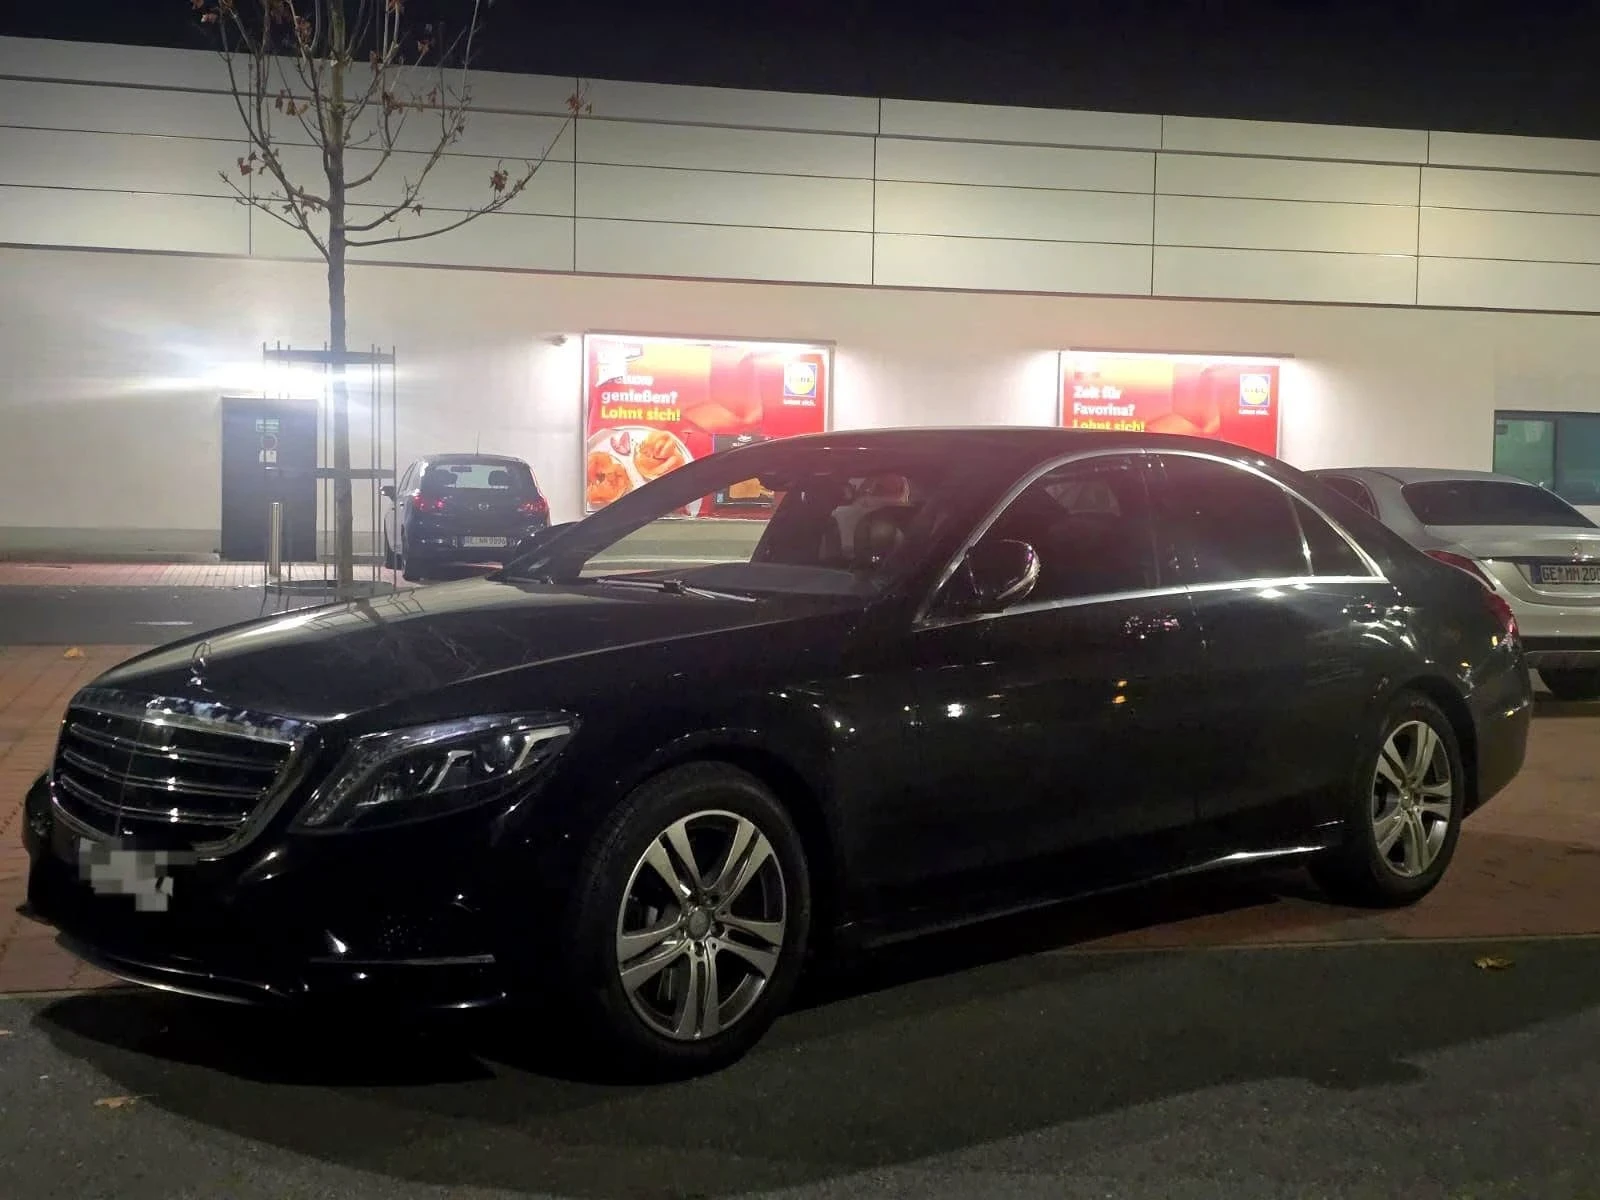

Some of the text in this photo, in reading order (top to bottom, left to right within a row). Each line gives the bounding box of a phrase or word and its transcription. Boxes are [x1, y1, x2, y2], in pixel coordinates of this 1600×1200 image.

[602, 389, 678, 404] genießen?
[602, 405, 681, 422] Lohnt sich!
[1074, 402, 1136, 417] Favorina?
[1073, 419, 1145, 433] Lohnt sich!
[1543, 567, 1558, 581] GE
